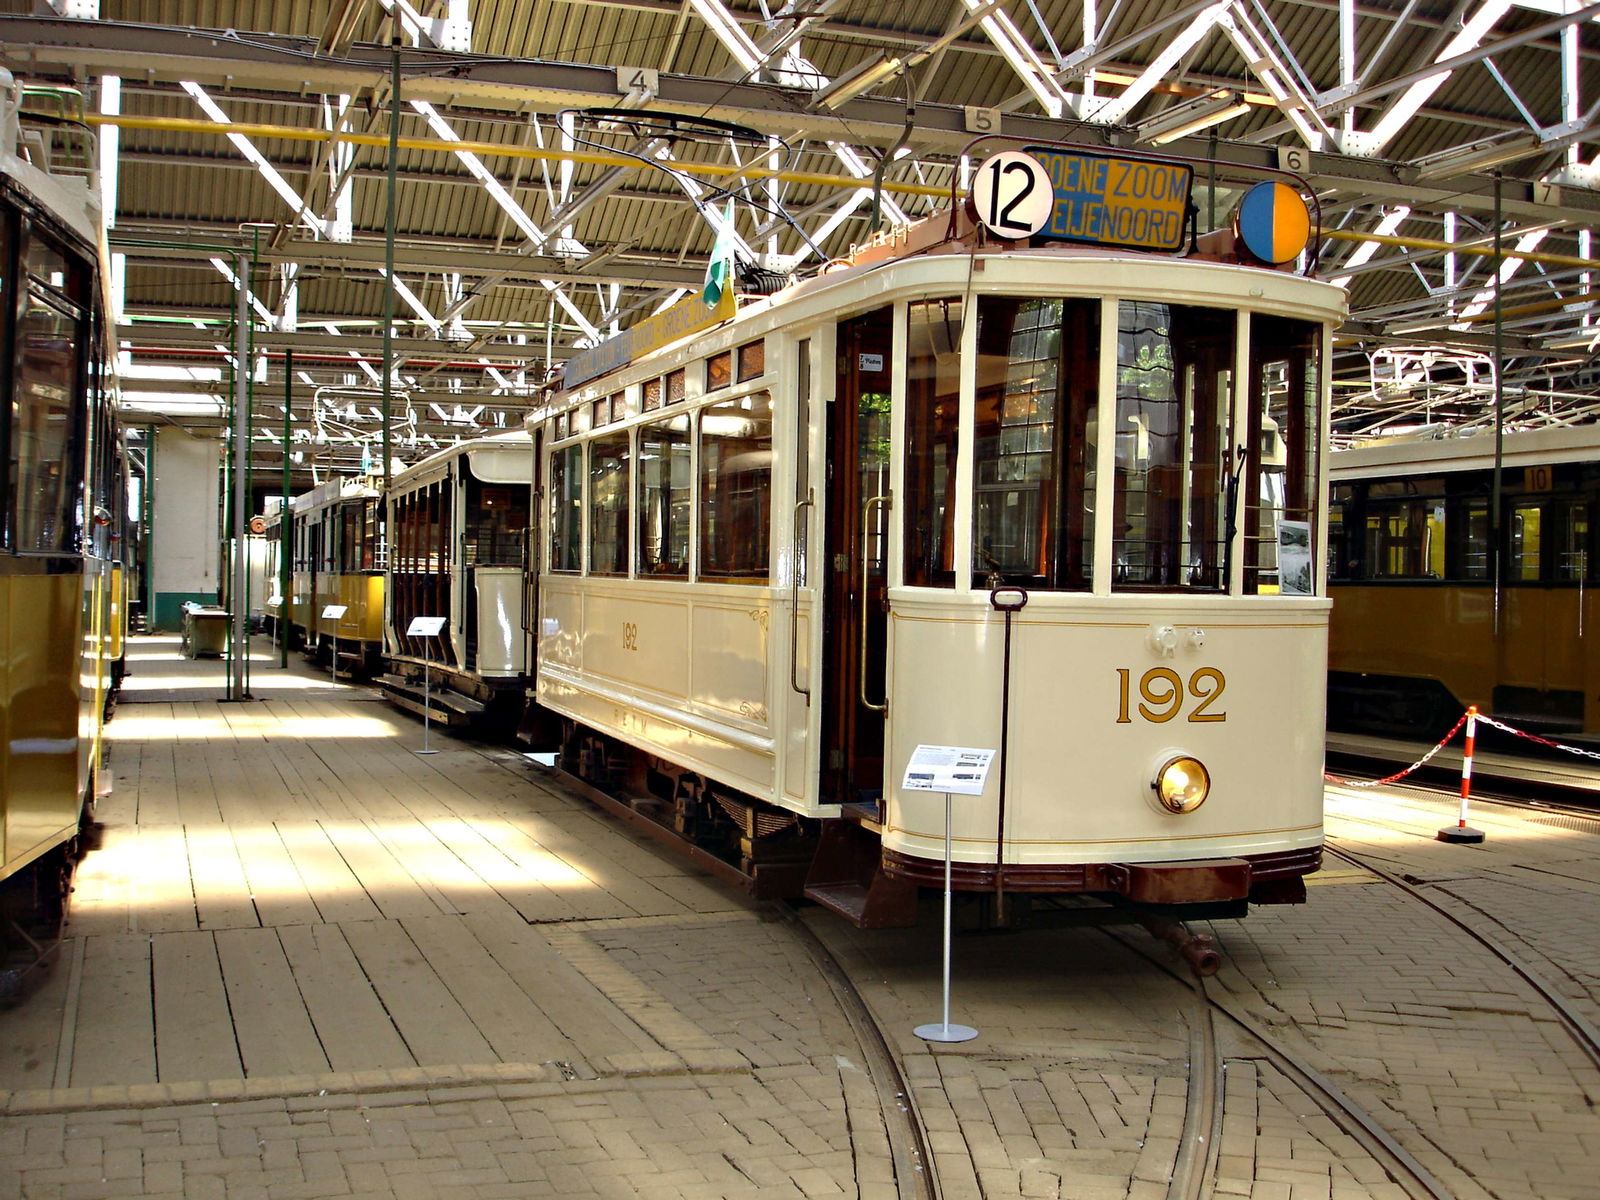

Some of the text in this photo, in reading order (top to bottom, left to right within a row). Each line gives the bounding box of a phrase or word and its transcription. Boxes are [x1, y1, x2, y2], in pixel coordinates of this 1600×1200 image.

[629, 70, 647, 91] 4
[976, 110, 992, 130] 5
[1287, 151, 1301, 170] 6
[1030, 152, 1188, 203] OENE ZOOM
[989, 158, 1036, 232] 12
[1542, 184, 1552, 202] 7
[1050, 198, 1180, 245] EIJENOORD
[1530, 468, 1547, 491] 10
[622, 622, 638, 651] 192
[1116, 666, 1227, 724] 192
